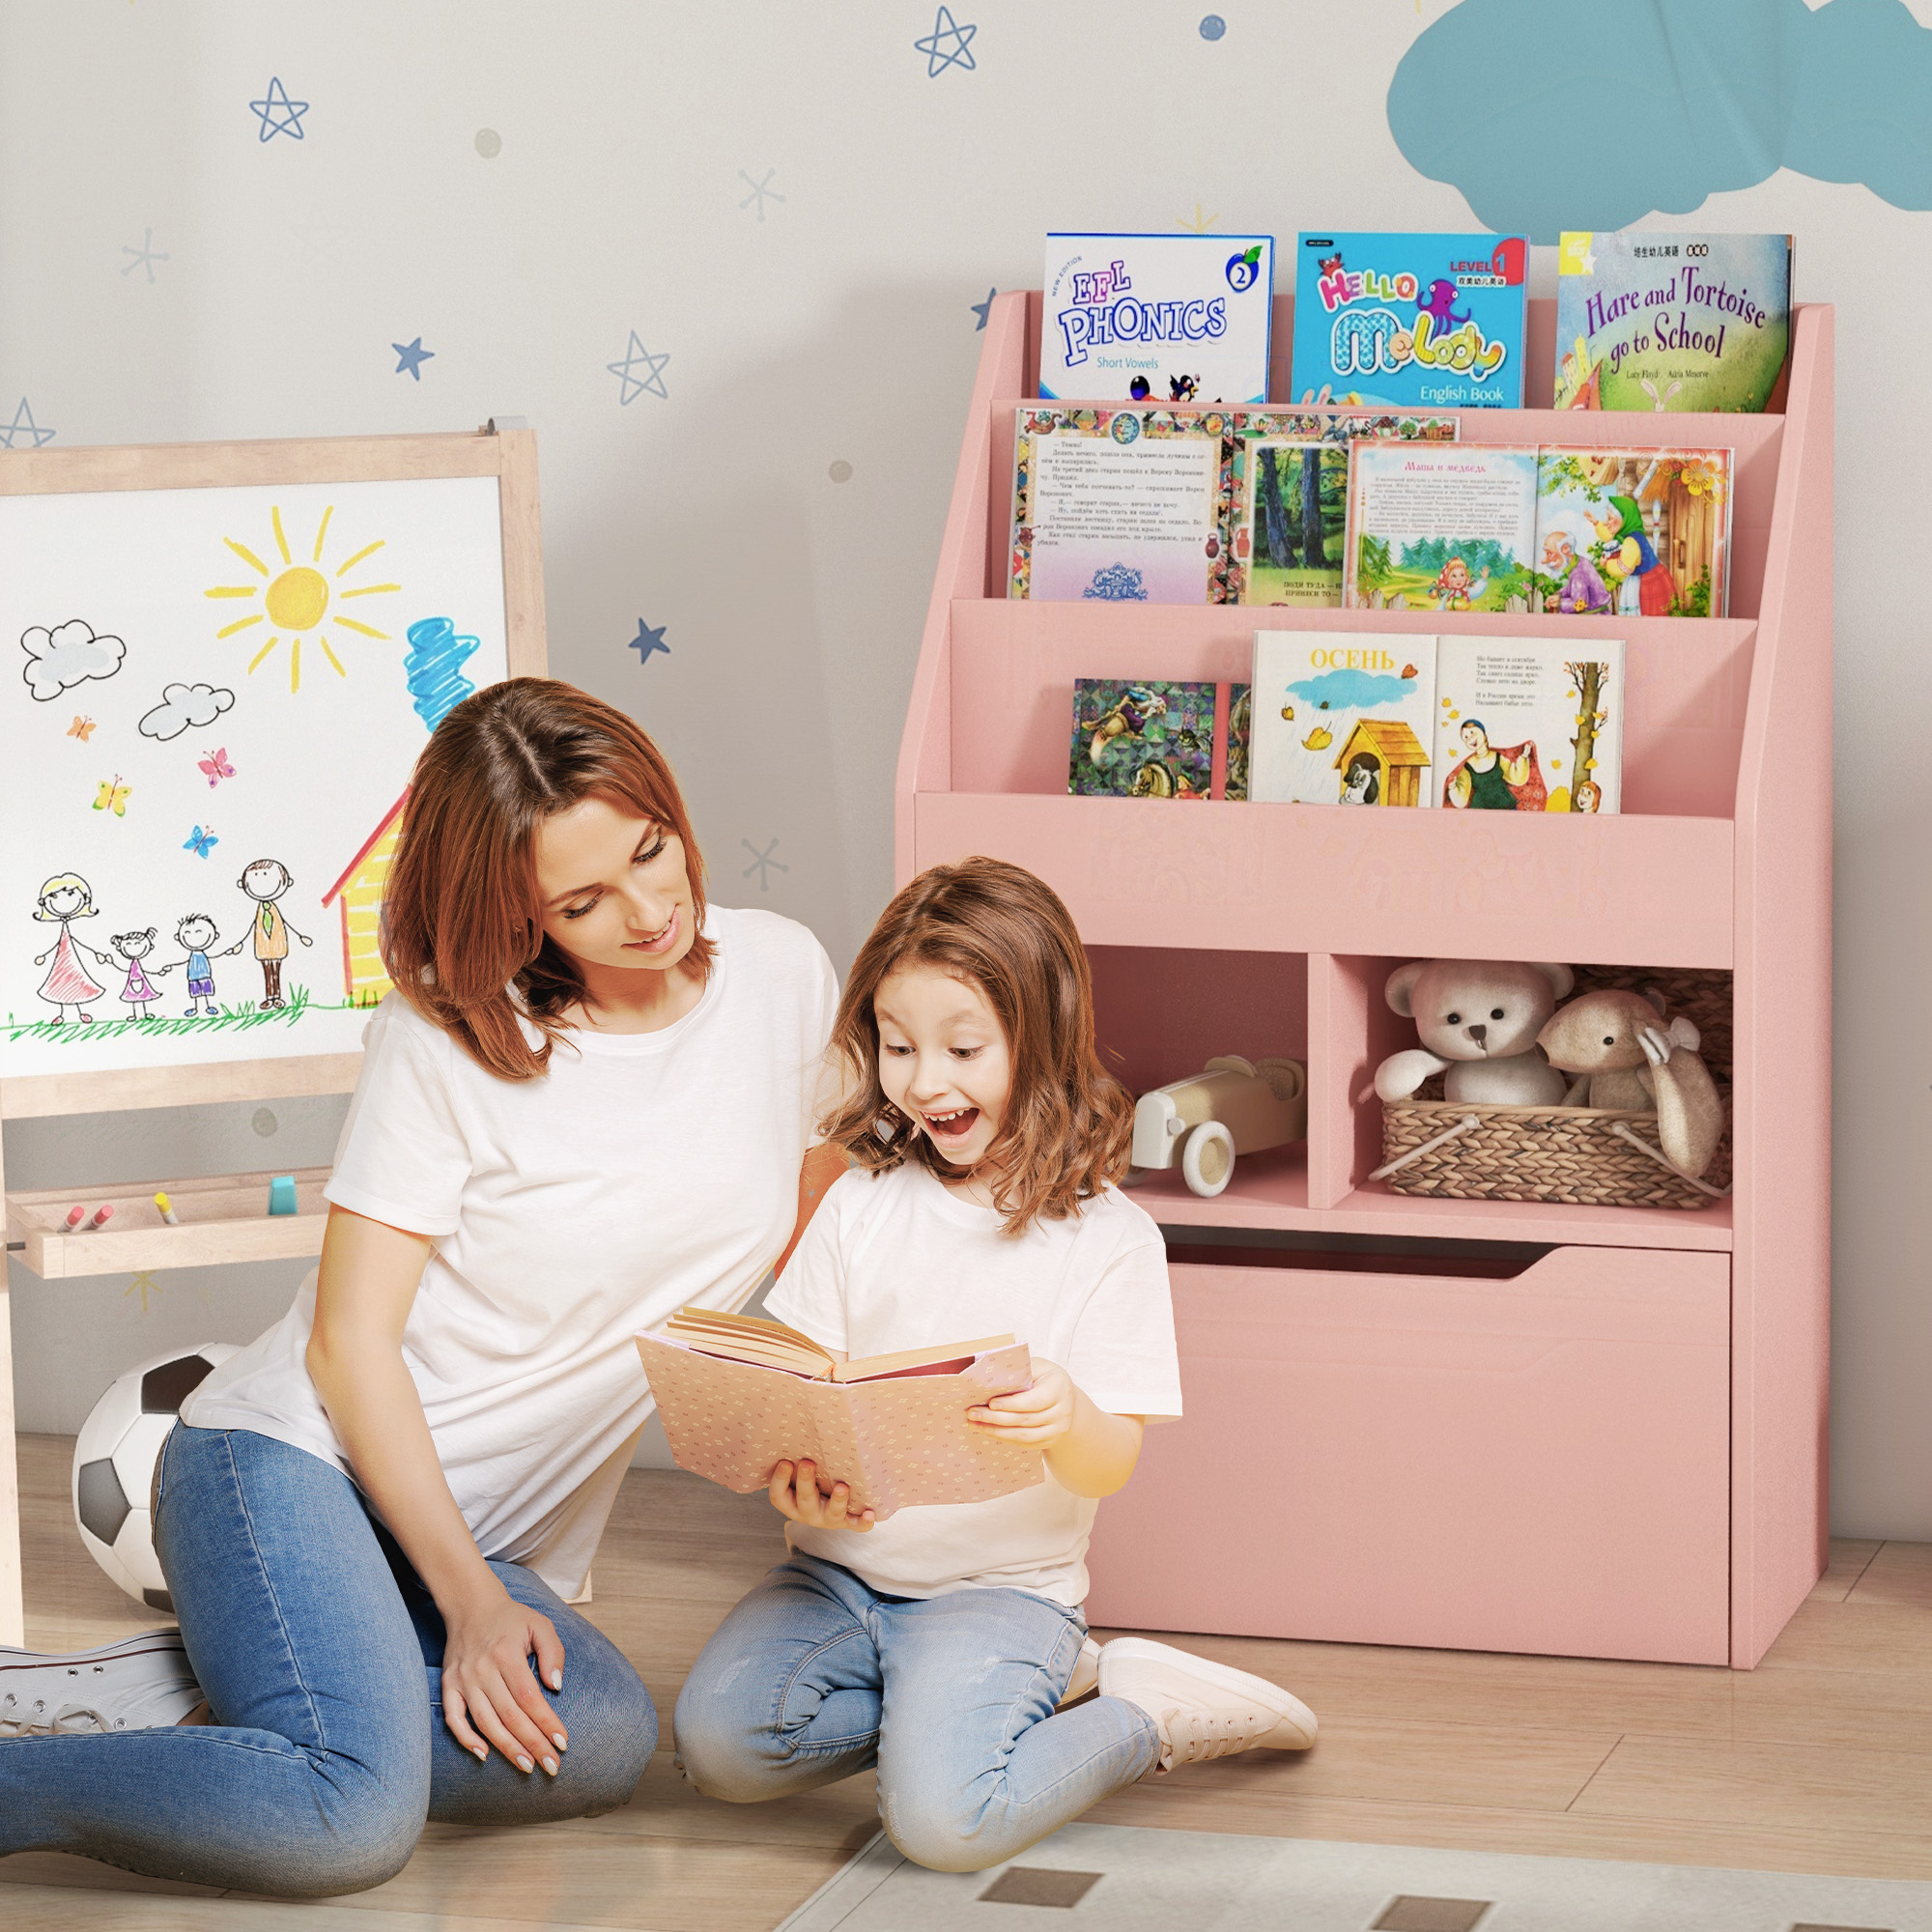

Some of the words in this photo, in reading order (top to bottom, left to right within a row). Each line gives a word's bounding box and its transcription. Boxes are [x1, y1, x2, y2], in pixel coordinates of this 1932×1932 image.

[1052, 277, 1061, 297] NEW
[1059, 255, 1083, 278] EDITION
[1236, 266, 1246, 284] 2
[1449, 261, 1492, 272] LEVEL
[1072, 260, 1131, 305] EFL
[1319, 270, 1417, 310] HELLO
[1585, 291, 1640, 339] Hare
[1644, 277, 1676, 307] and
[1682, 266, 1766, 329] Tortoise
[1058, 297, 1227, 367] PHONICS
[1610, 340, 1630, 375] go
[1634, 330, 1650, 355] to
[1654, 311, 1725, 358] School
[1096, 356, 1123, 369] Short
[1125, 357, 1159, 369] Vowels
[1420, 385, 1466, 404] English
[1470, 386, 1504, 401] Book
[1405, 461, 1435, 471] Маша
[1446, 464, 1487, 473] медведь
[1310, 647, 1395, 670] ОСЕНЬ
